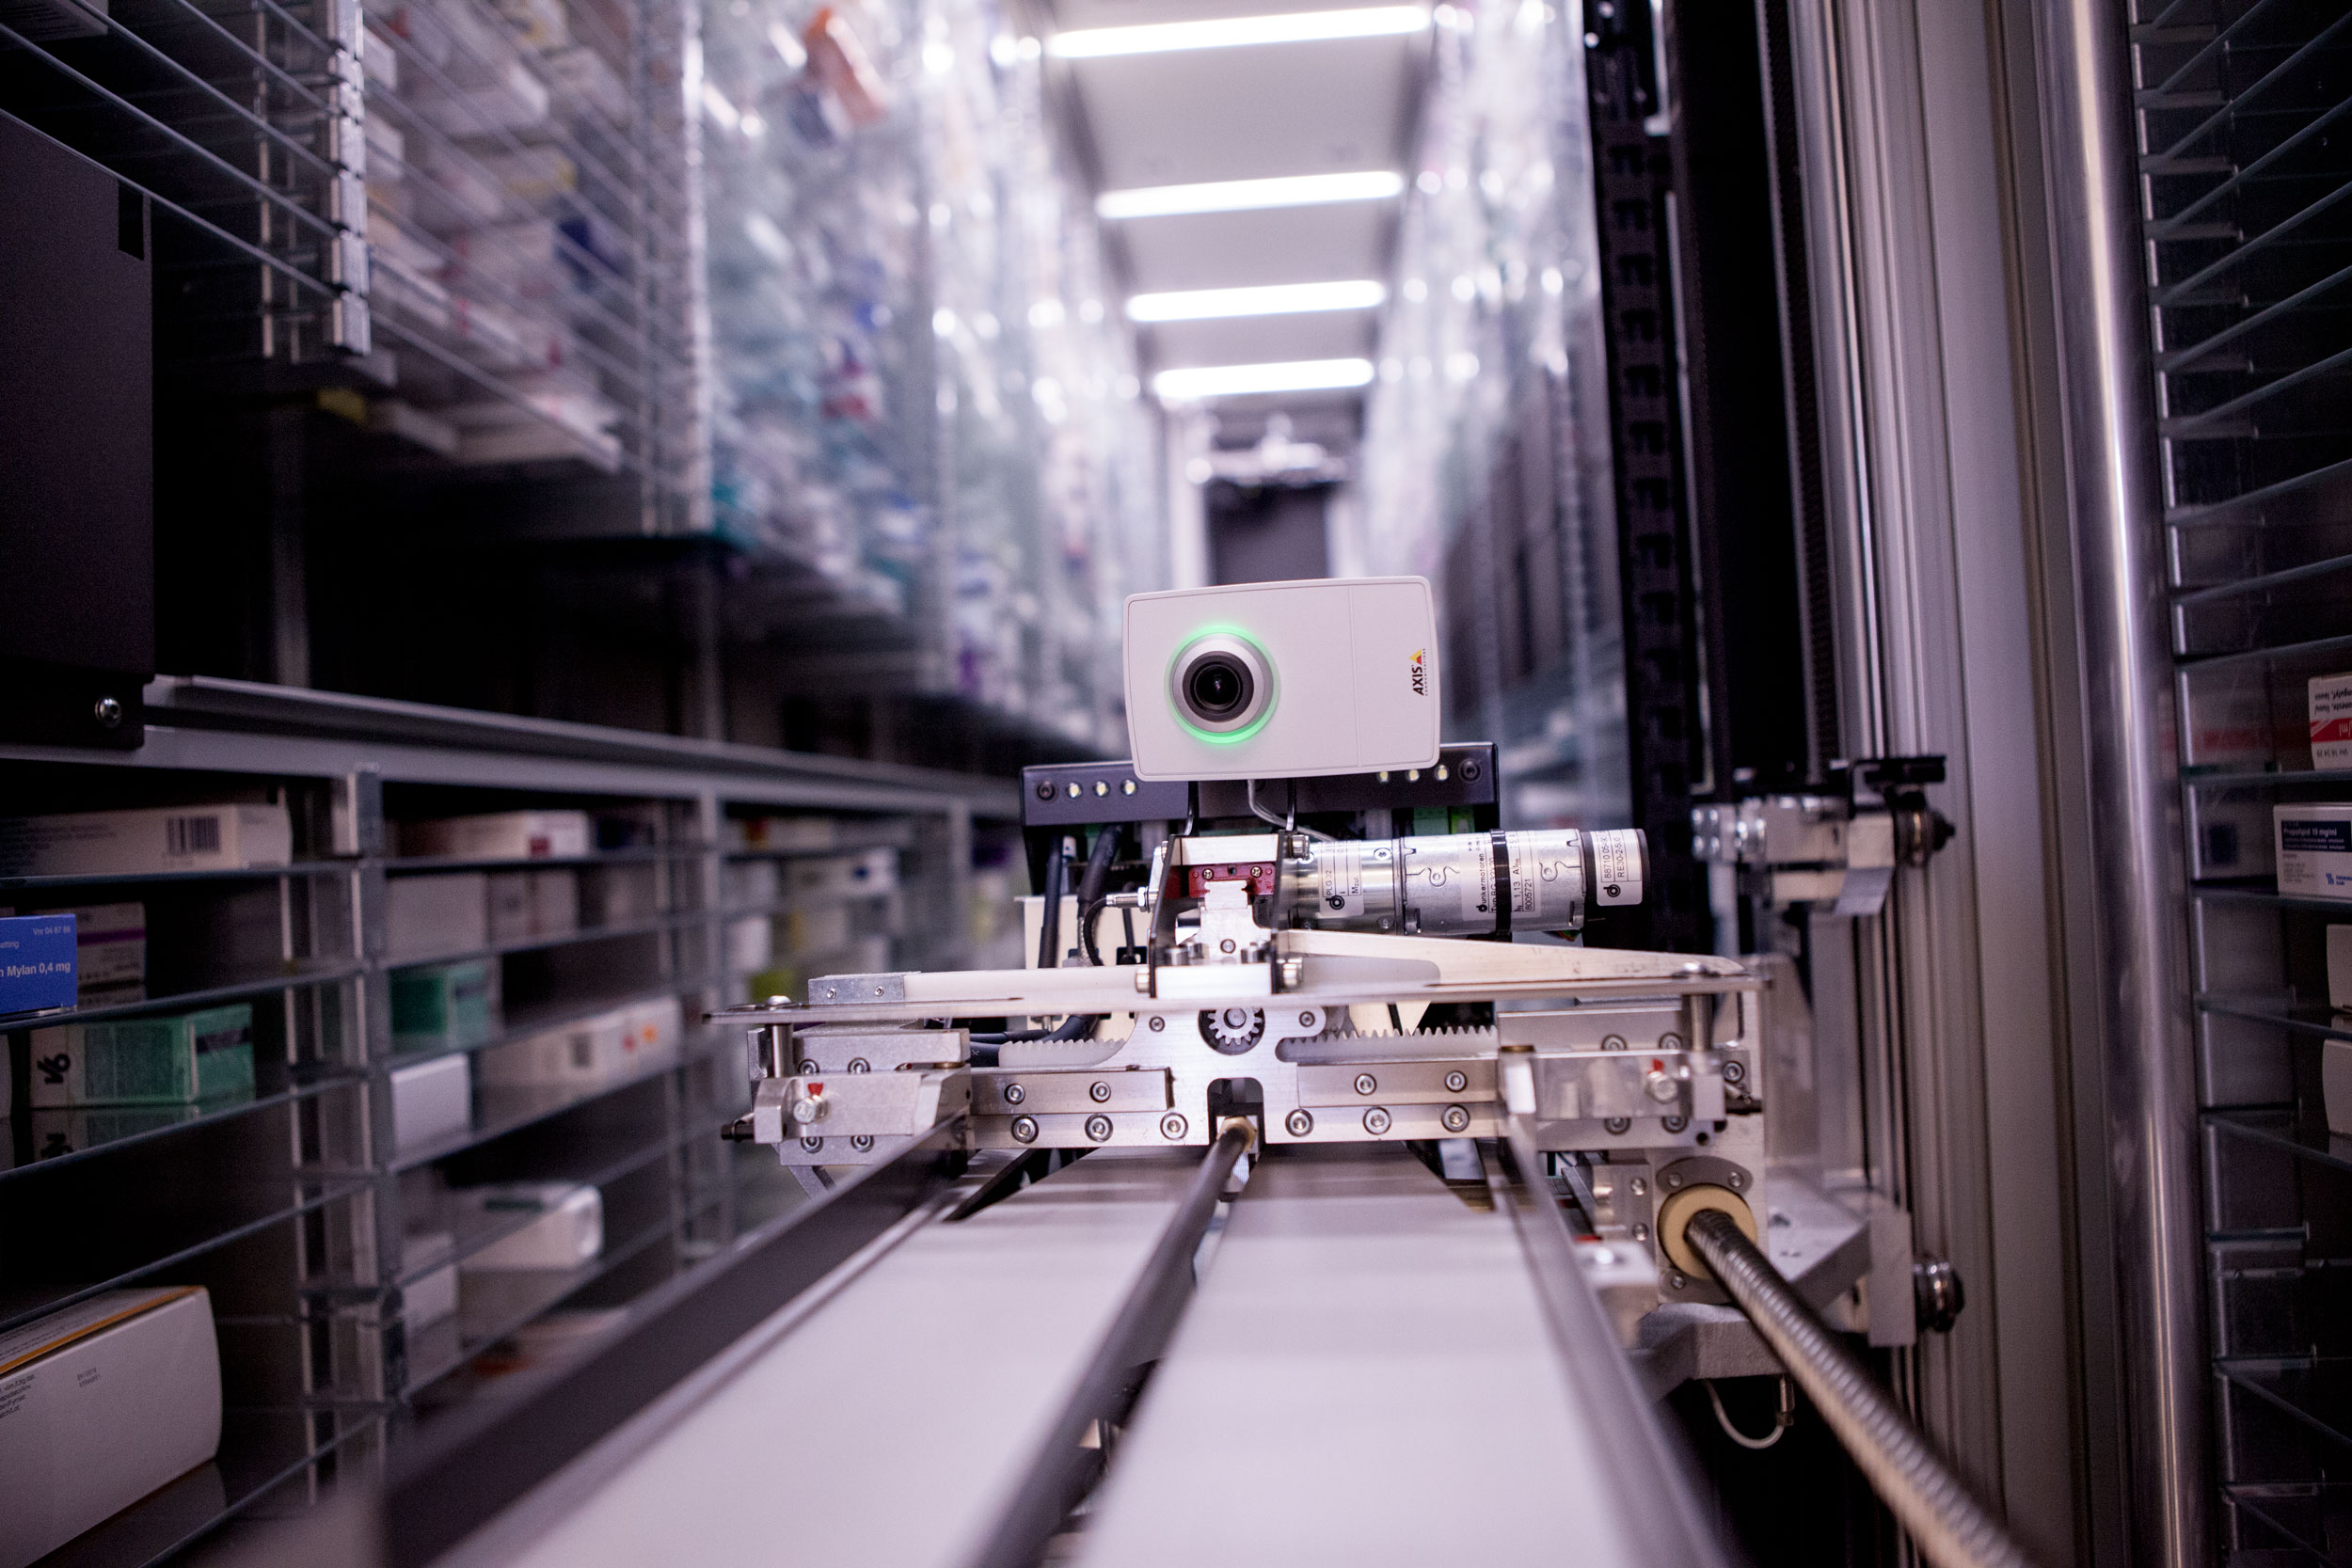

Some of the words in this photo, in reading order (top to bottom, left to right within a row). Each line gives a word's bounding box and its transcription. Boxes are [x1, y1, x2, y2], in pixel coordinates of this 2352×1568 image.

[1411, 666, 1423, 696] AXIS
[1603, 855, 1612, 879] 88710
[1524, 879, 1533, 911] 8005721
[7, 965, 37, 978] Mylan
[39, 962, 54, 975] 0,4
[56, 962, 72, 974] mg
